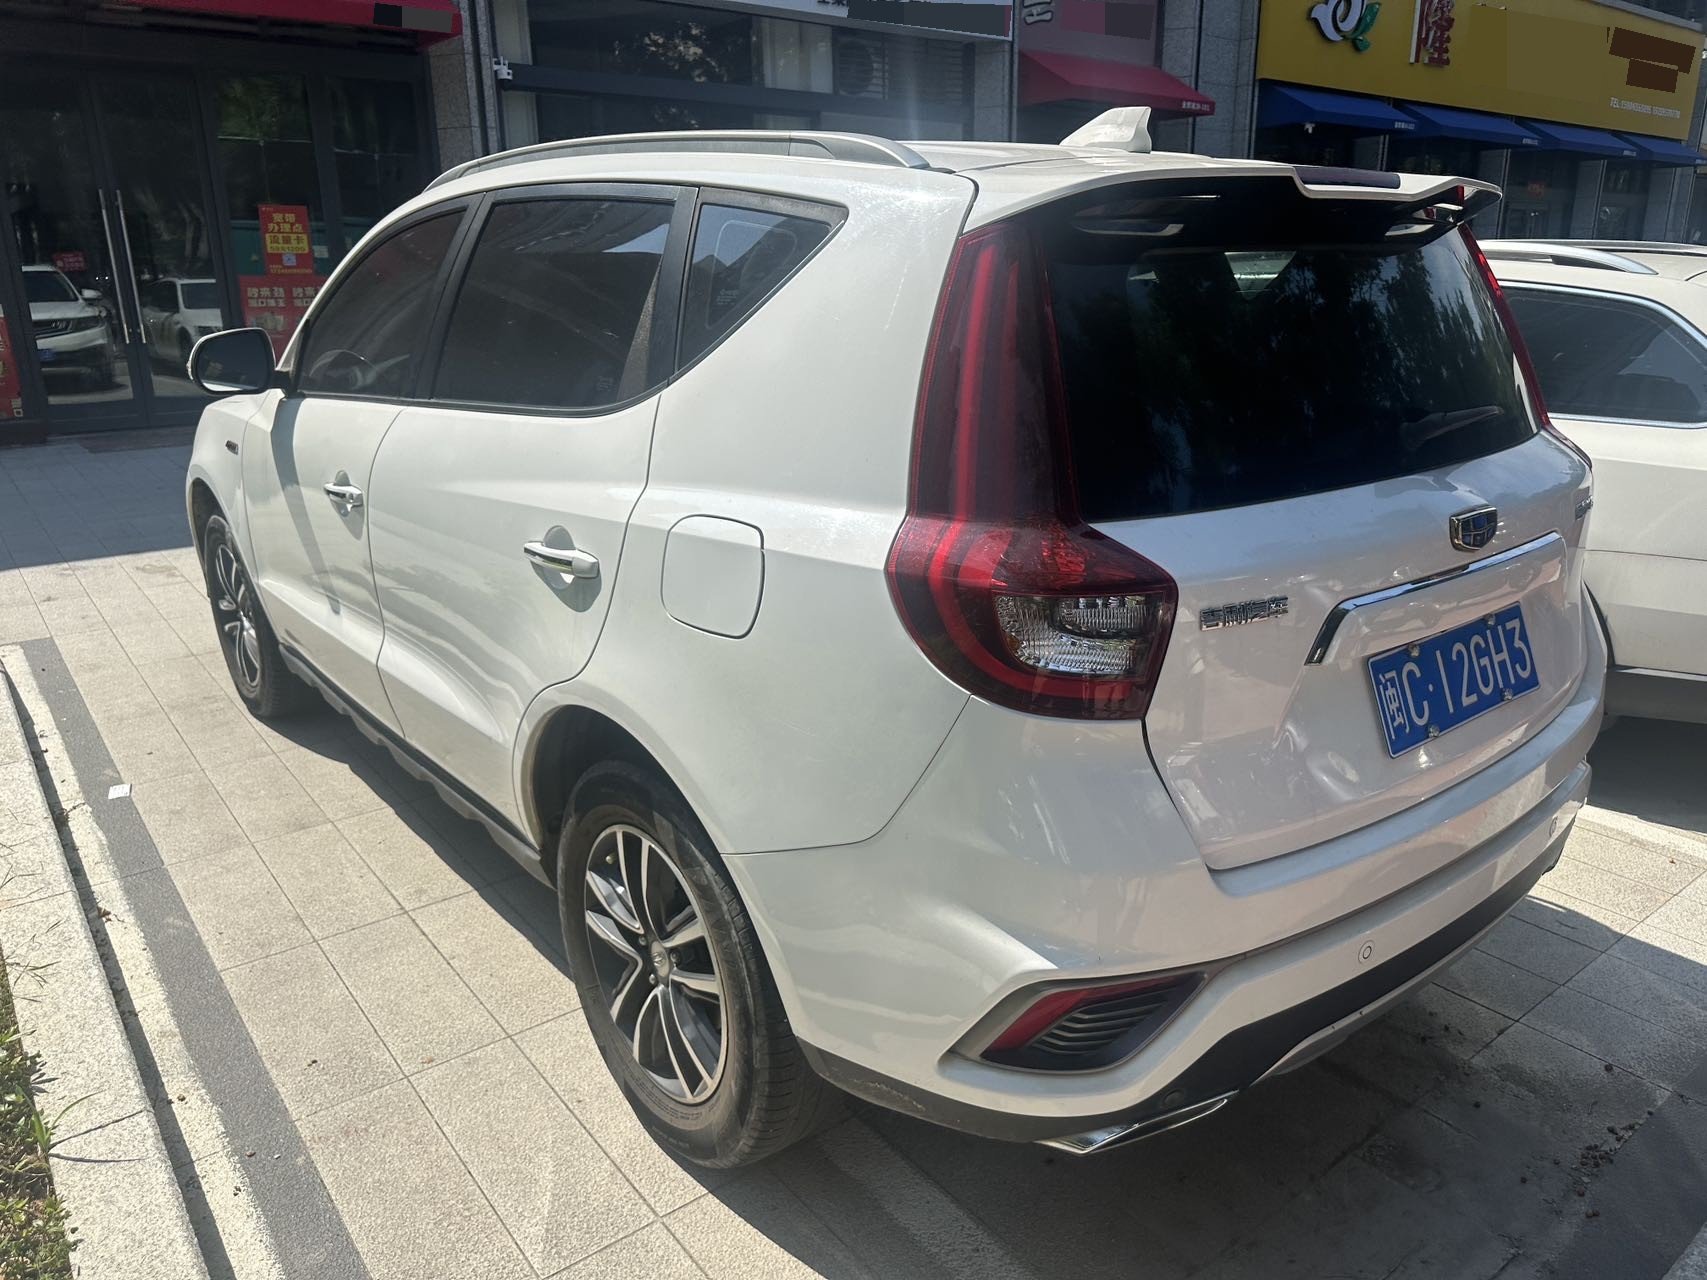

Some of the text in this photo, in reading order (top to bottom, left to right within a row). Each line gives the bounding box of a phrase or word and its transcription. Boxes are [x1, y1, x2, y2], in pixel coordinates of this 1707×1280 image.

[267, 223, 304, 233] 办理点
[269, 235, 305, 246] 流量卡
